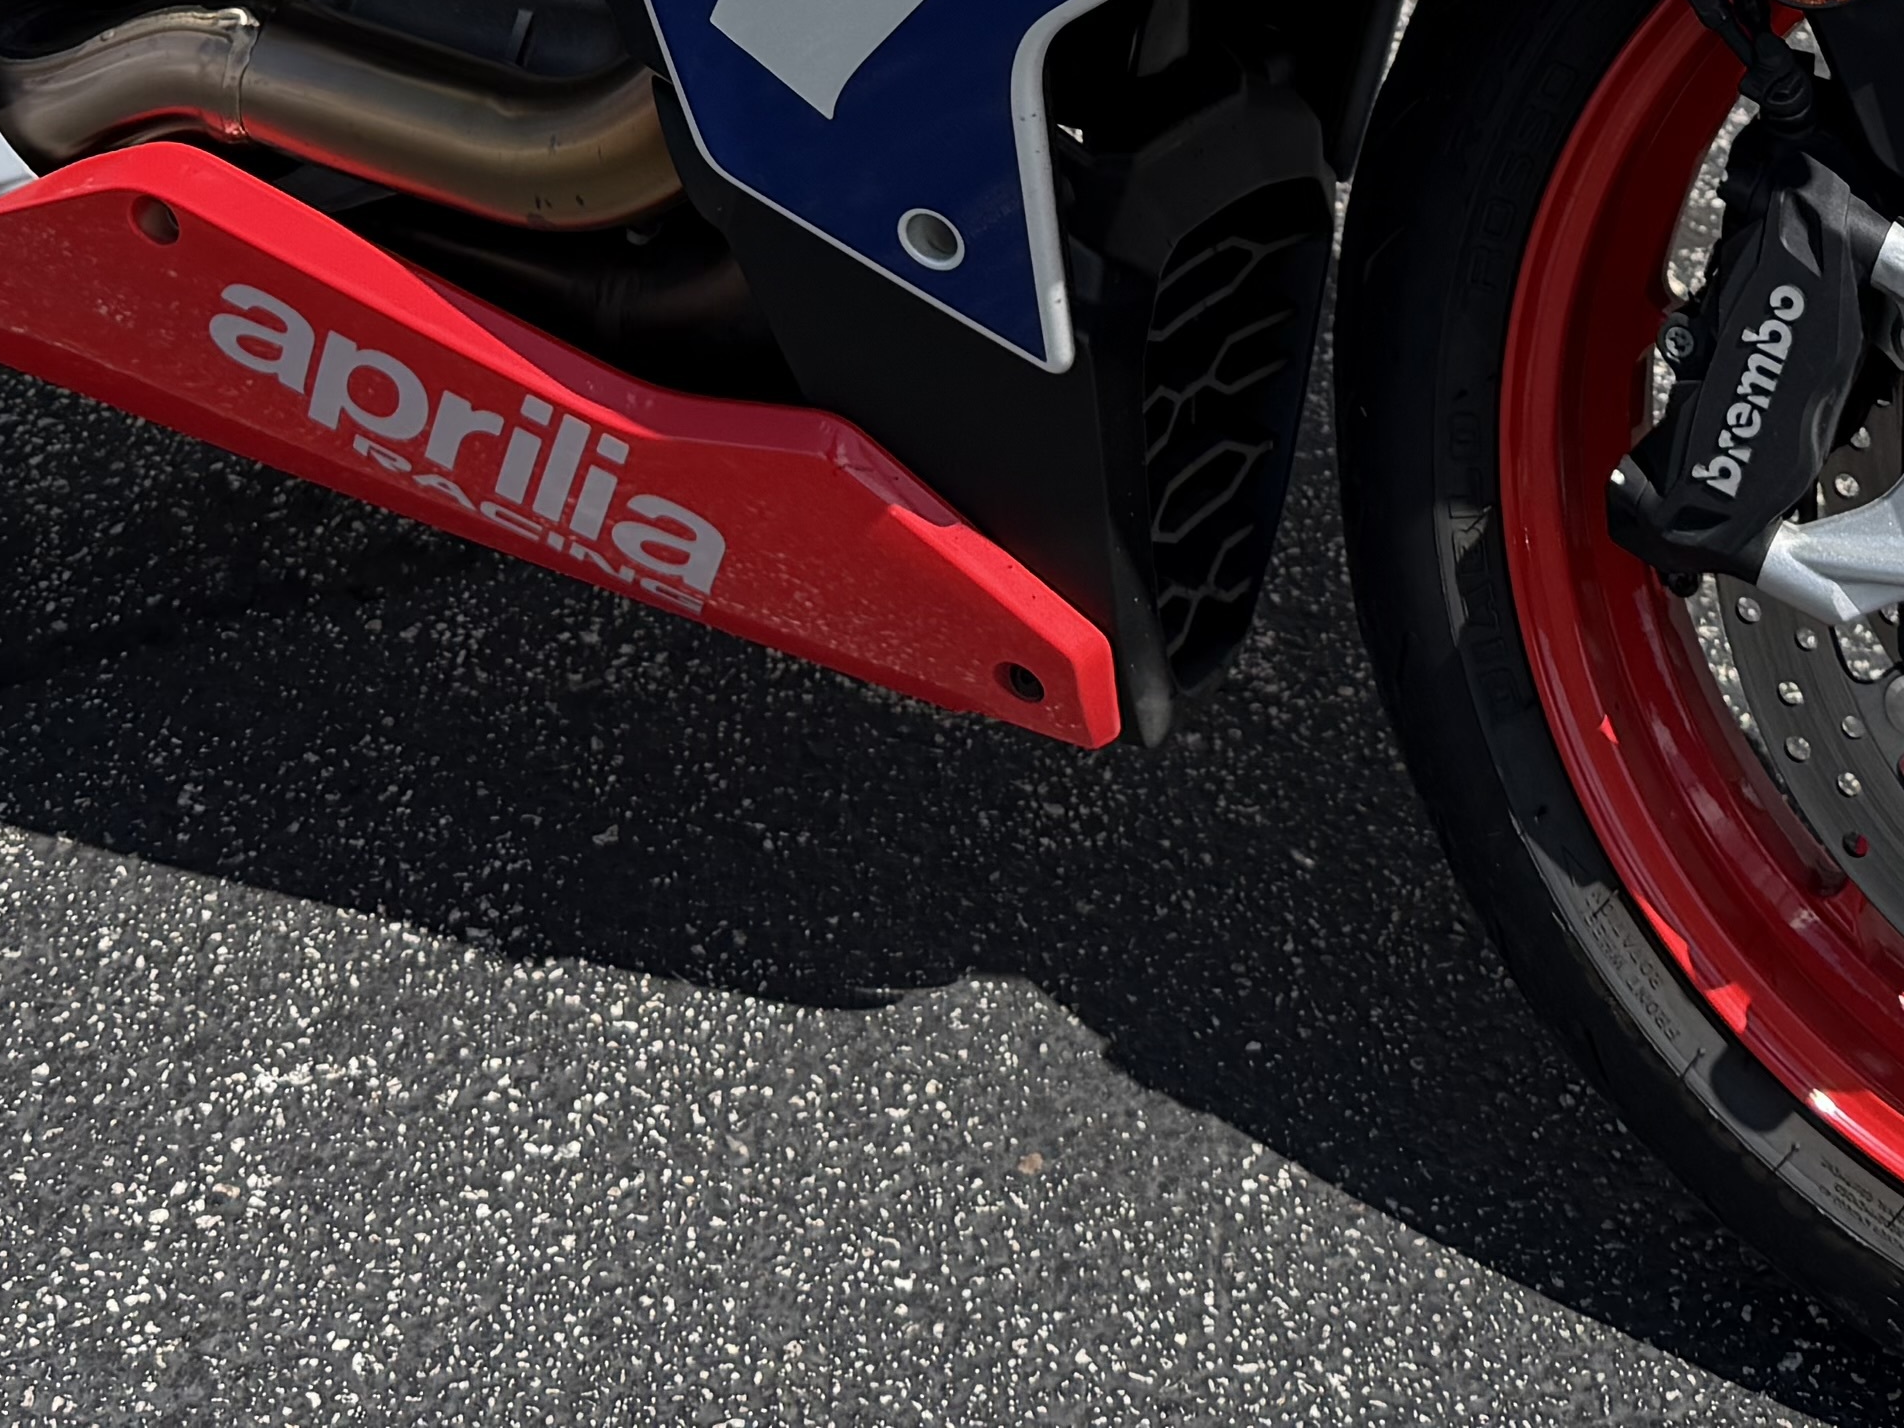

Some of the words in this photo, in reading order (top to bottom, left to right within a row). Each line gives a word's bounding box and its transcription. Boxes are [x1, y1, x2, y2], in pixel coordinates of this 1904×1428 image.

[208, 282, 727, 596] aprilia
[1691, 284, 1805, 498] brembo
[351, 433, 706, 616] RACING
[1622, 972, 1682, 1044] FRONT
